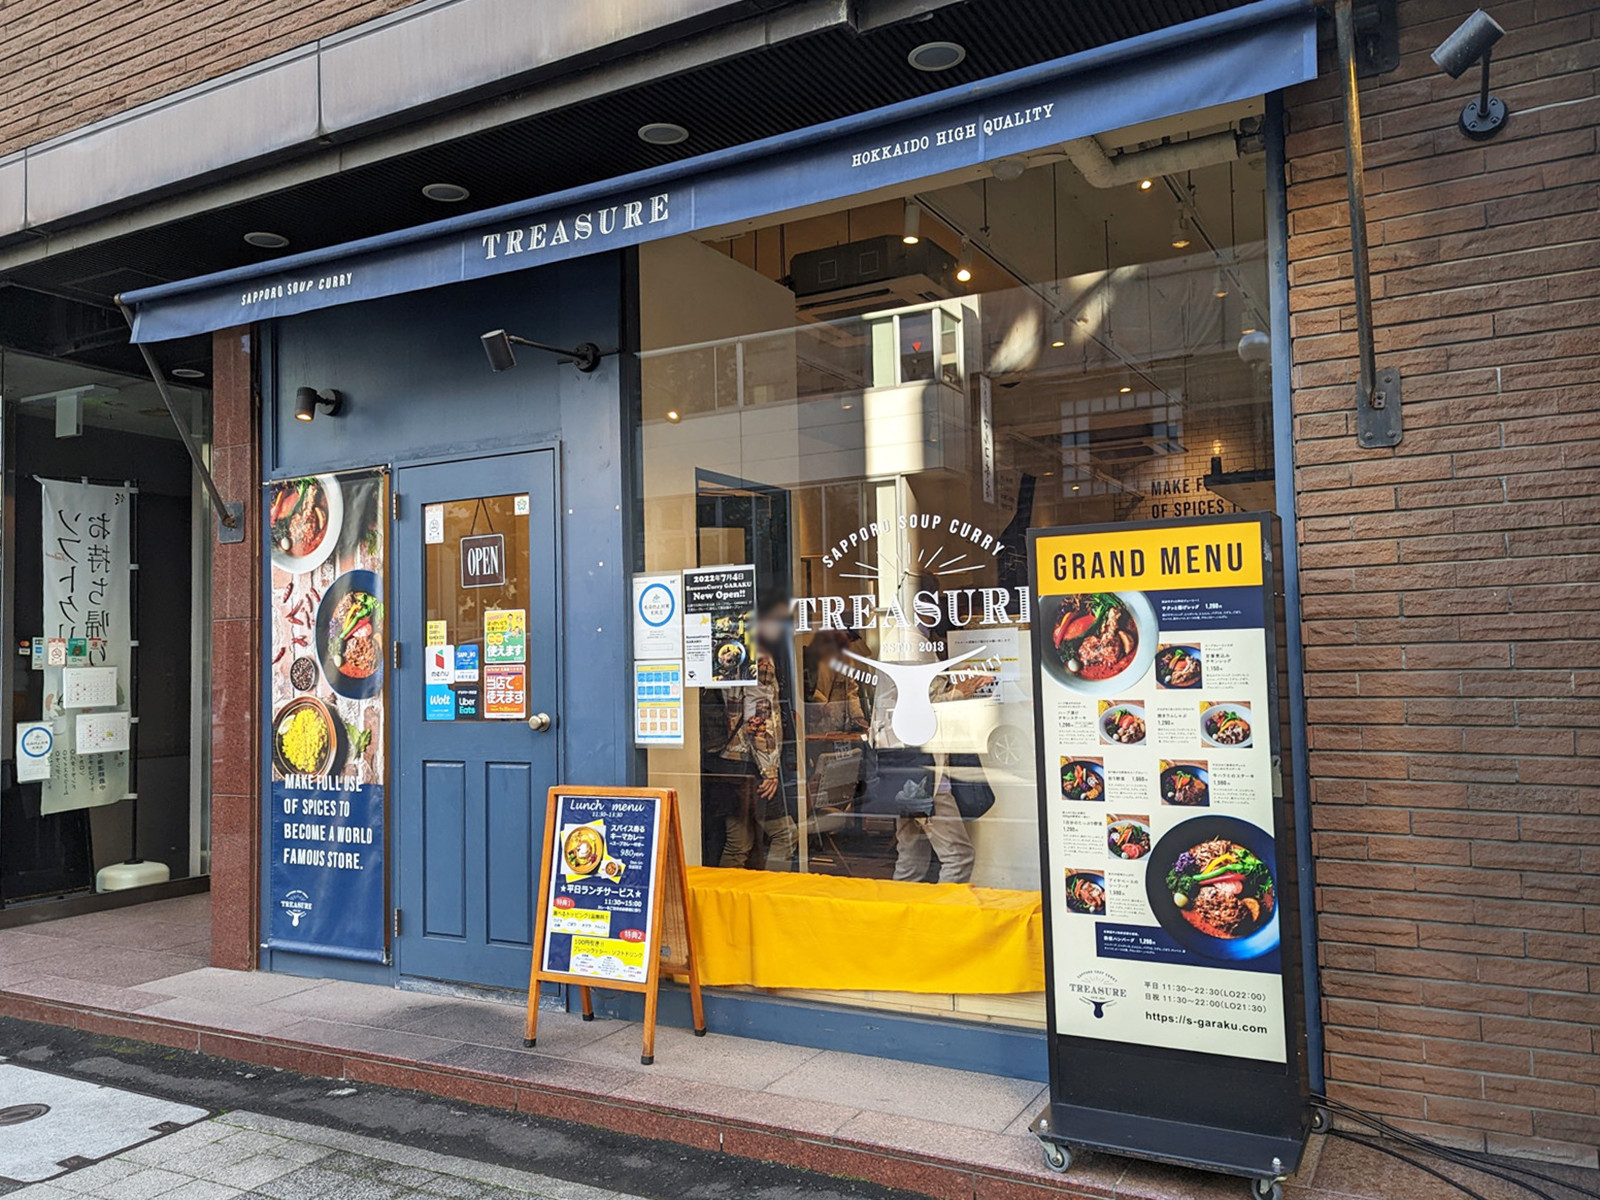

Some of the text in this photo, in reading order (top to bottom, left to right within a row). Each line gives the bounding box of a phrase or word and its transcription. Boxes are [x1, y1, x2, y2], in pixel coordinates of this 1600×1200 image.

[851, 103, 1054, 167] HOKKAIDO HIGH QUALITY
[482, 193, 670, 260] TREASURE
[241, 272, 353, 306] SAPPORO SOUP CURRY
[1151, 478, 1190, 496] MAKE
[1151, 503, 1169, 519] OF
[1173, 499, 1225, 518] SPICES
[822, 513, 1006, 569] SAPPORO SOUP CURRY
[467, 546, 499, 576] OPEN
[1053, 542, 1243, 581] GRAND MENU
[693, 589, 746, 601] New Open!!
[487, 645, 523, 657] 使えます
[918, 641, 944, 653] 2013
[950, 654, 1003, 685] QUALITY
[487, 676, 515, 690] 当店で
[430, 694, 451, 706] Wolt
[458, 697, 476, 706] Uber
[487, 690, 524, 704] 使えます
[459, 706, 476, 715] Eats
[284, 773, 314, 791] MAKE
[343, 775, 363, 792] USE
[283, 798, 351, 818] OF SPICES TO
[569, 799, 645, 812] Lunch menu
[283, 822, 373, 845] BECOME A WORLD
[609, 833, 645, 841] キーマカレー
[283, 848, 364, 870] FAMOUS STORE.
[567, 884, 635, 898] 平日ランチサービス
[280, 900, 313, 910] TREASURE
[1069, 983, 1127, 998] TREASURE
[1144, 980, 1159, 991] 平日
[1144, 992, 1160, 1002] 日祝
[1145, 1011, 1268, 1035] https://s-garaku.com
